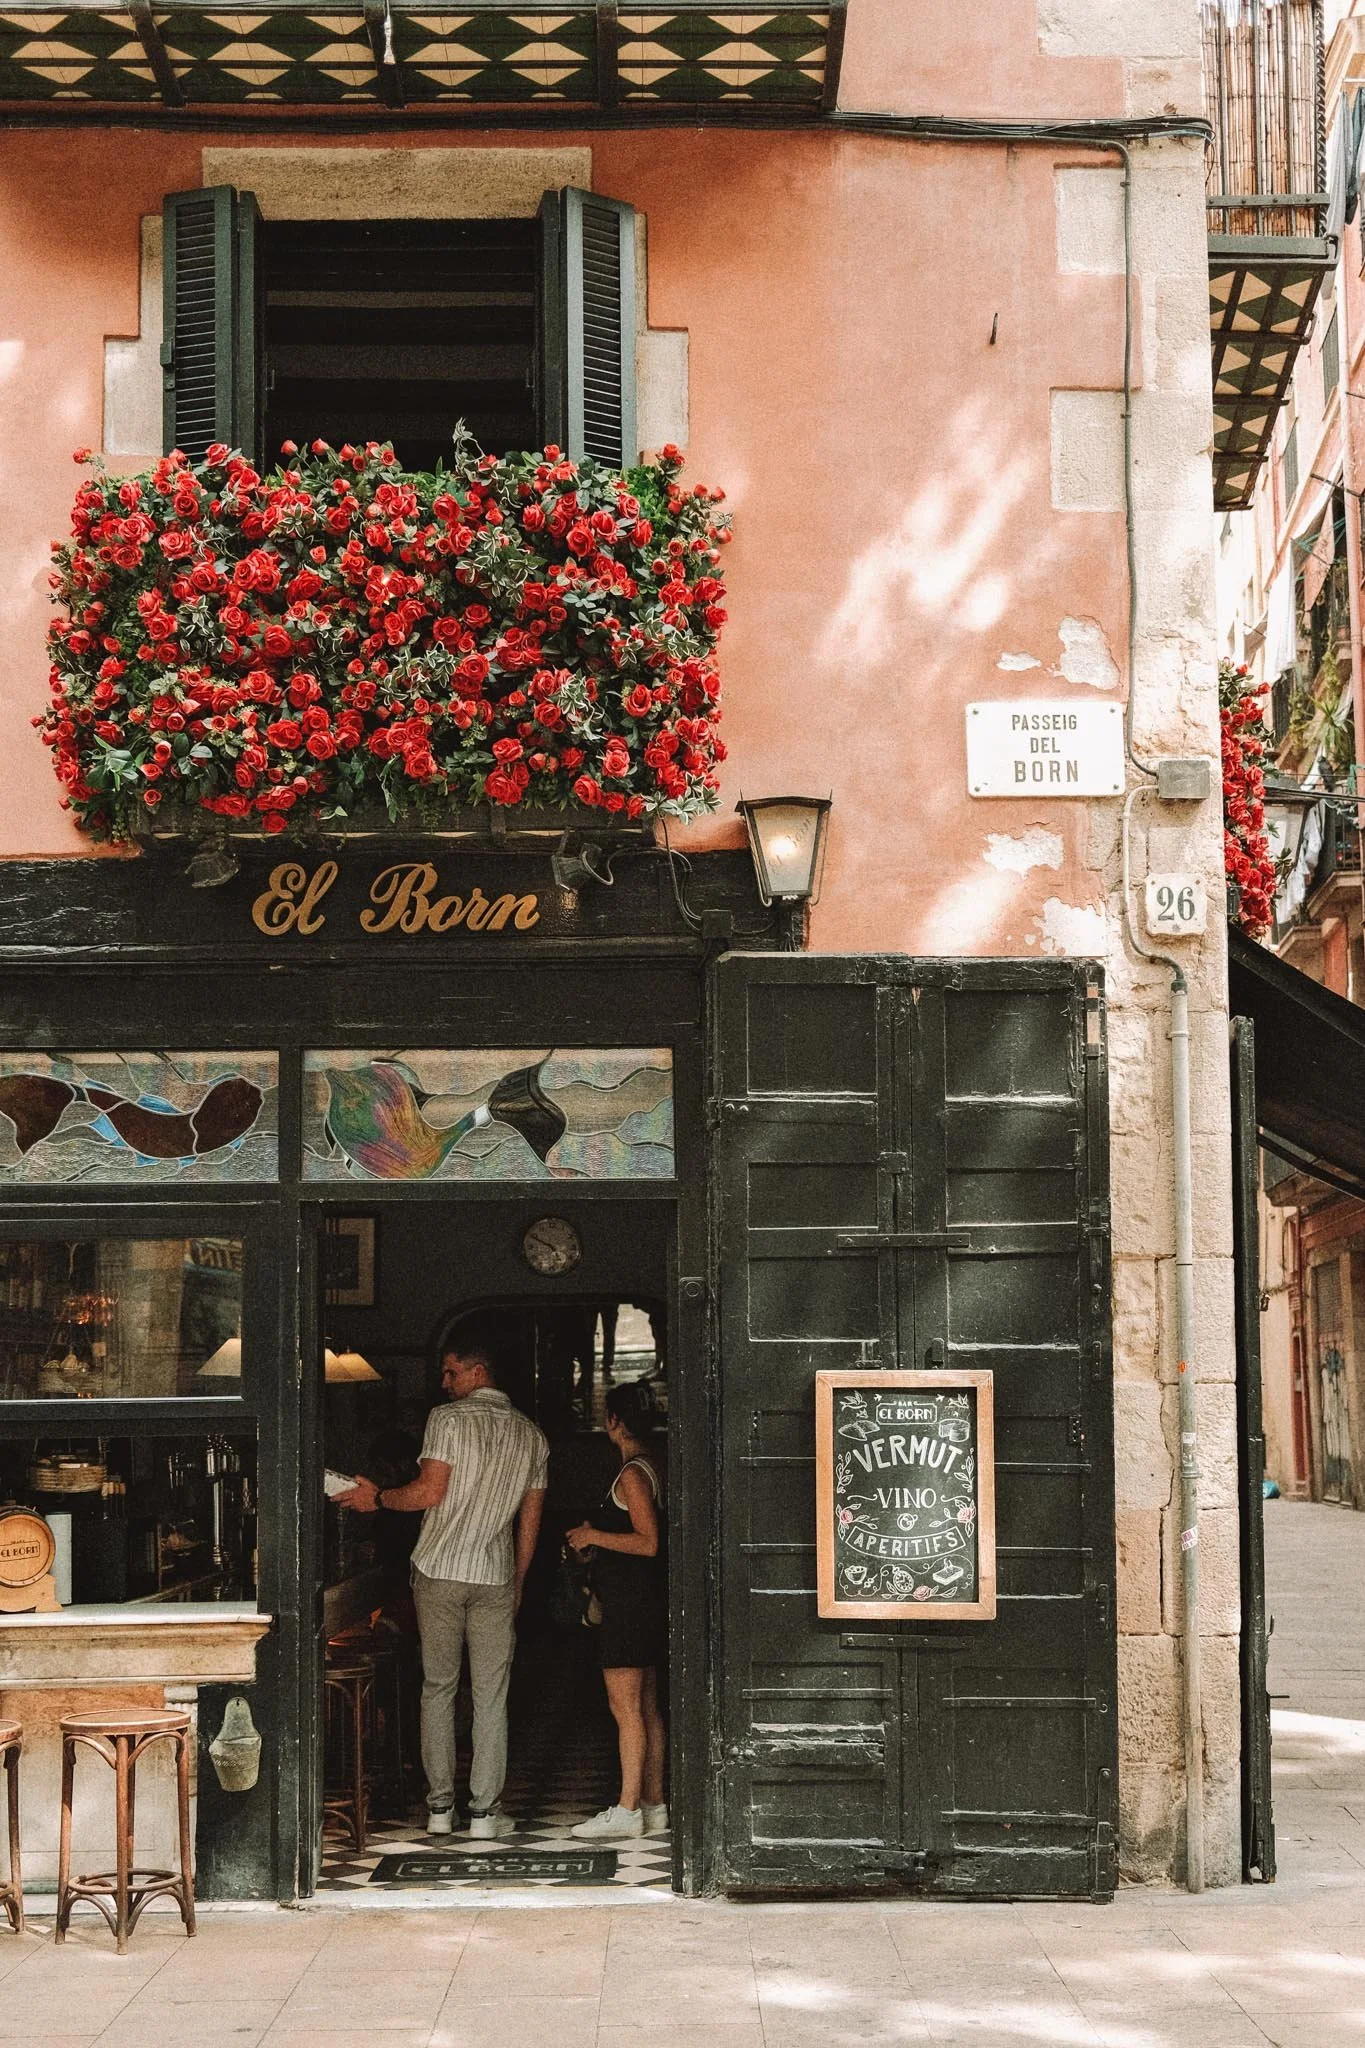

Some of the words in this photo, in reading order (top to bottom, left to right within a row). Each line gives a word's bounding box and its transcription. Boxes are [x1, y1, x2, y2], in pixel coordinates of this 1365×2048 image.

[1012, 714, 1078, 731] PASSEIG
[1030, 737, 1061, 754] DEL
[1014, 760, 1079, 783] BORN
[252, 860, 339, 936] El
[359, 862, 541, 935] Born
[1156, 886, 1196, 921] 26
[879, 1408, 893, 1420] EL
[896, 1408, 933, 1420] BORN
[852, 1434, 963, 1474] VERMUT
[877, 1487, 937, 1509] VINO
[13, 1546, 38, 1556] BORN
[854, 1531, 958, 1556] APERITIFS
[467, 1863, 583, 1873] BORN
